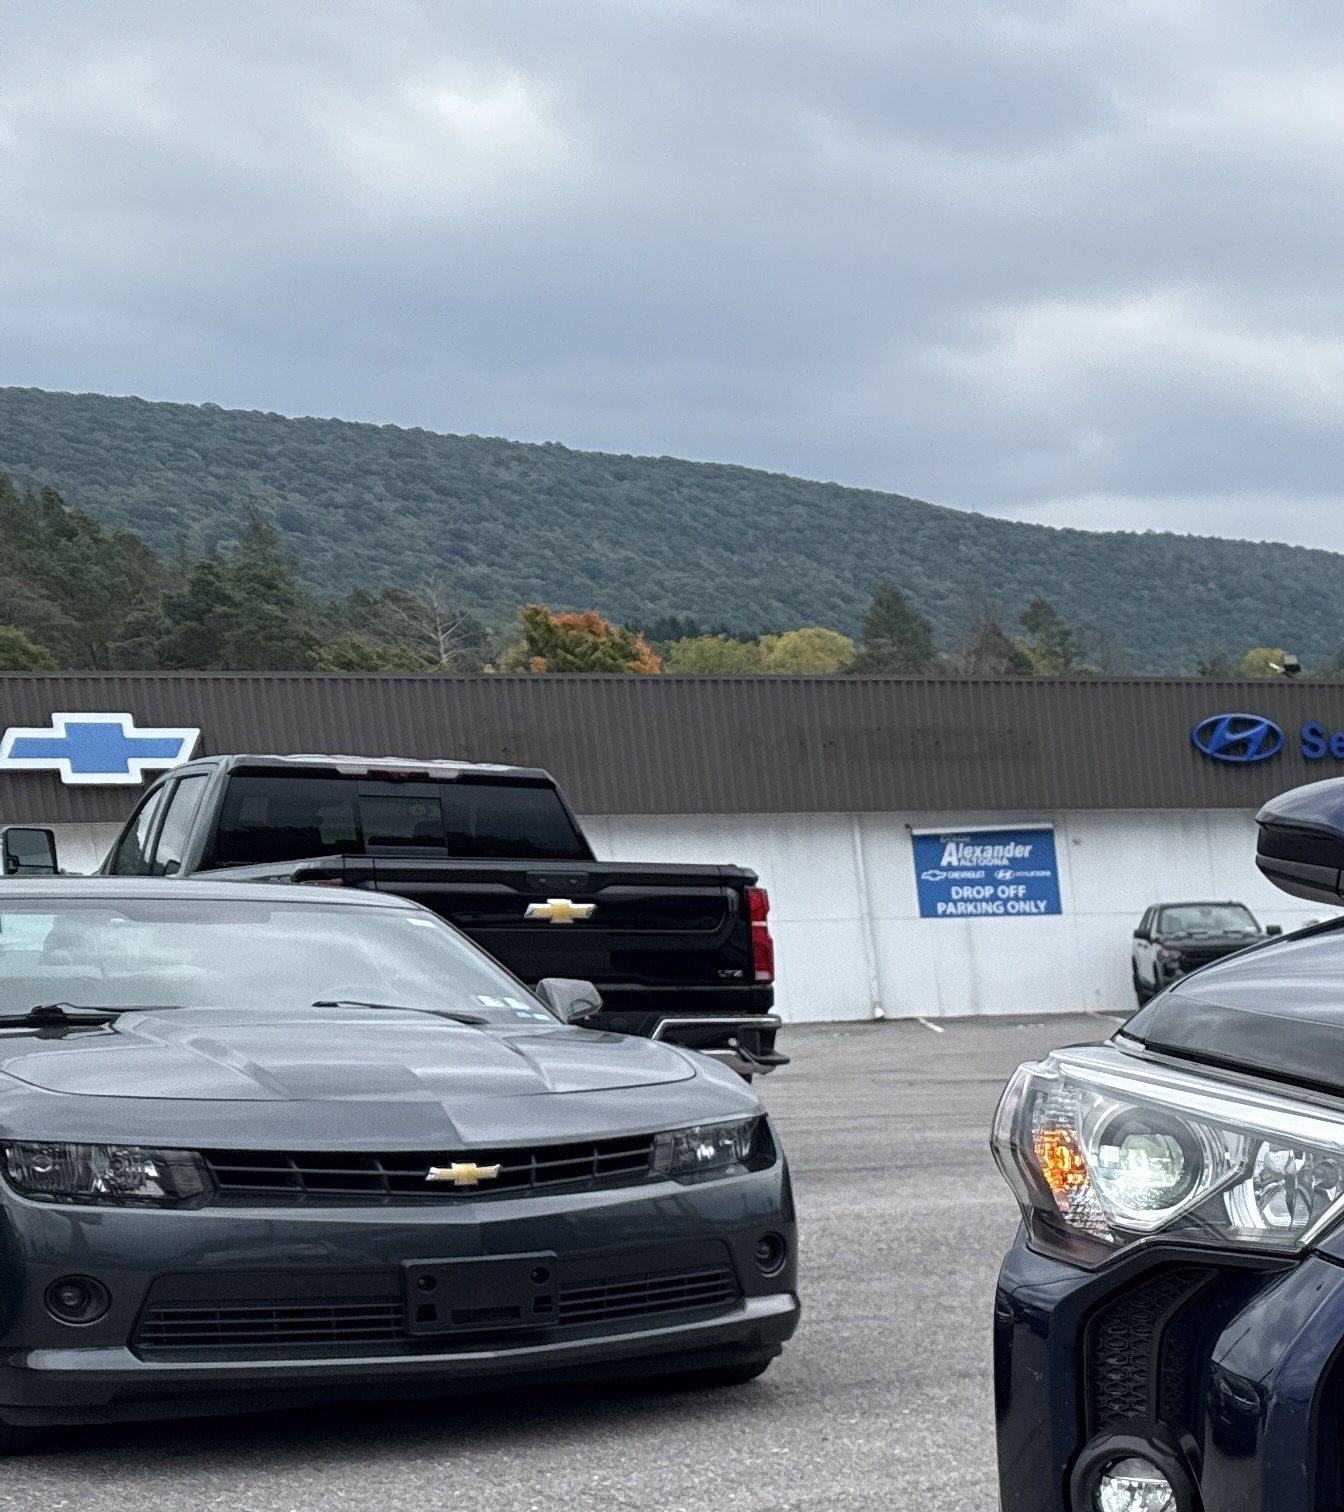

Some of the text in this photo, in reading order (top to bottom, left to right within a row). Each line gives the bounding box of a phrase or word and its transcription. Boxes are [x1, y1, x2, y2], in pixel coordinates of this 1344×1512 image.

[940, 841, 1033, 867] Alexander
[951, 885, 1027, 900] DROP OFF
[936, 900, 1048, 915] PARKING ONLY
